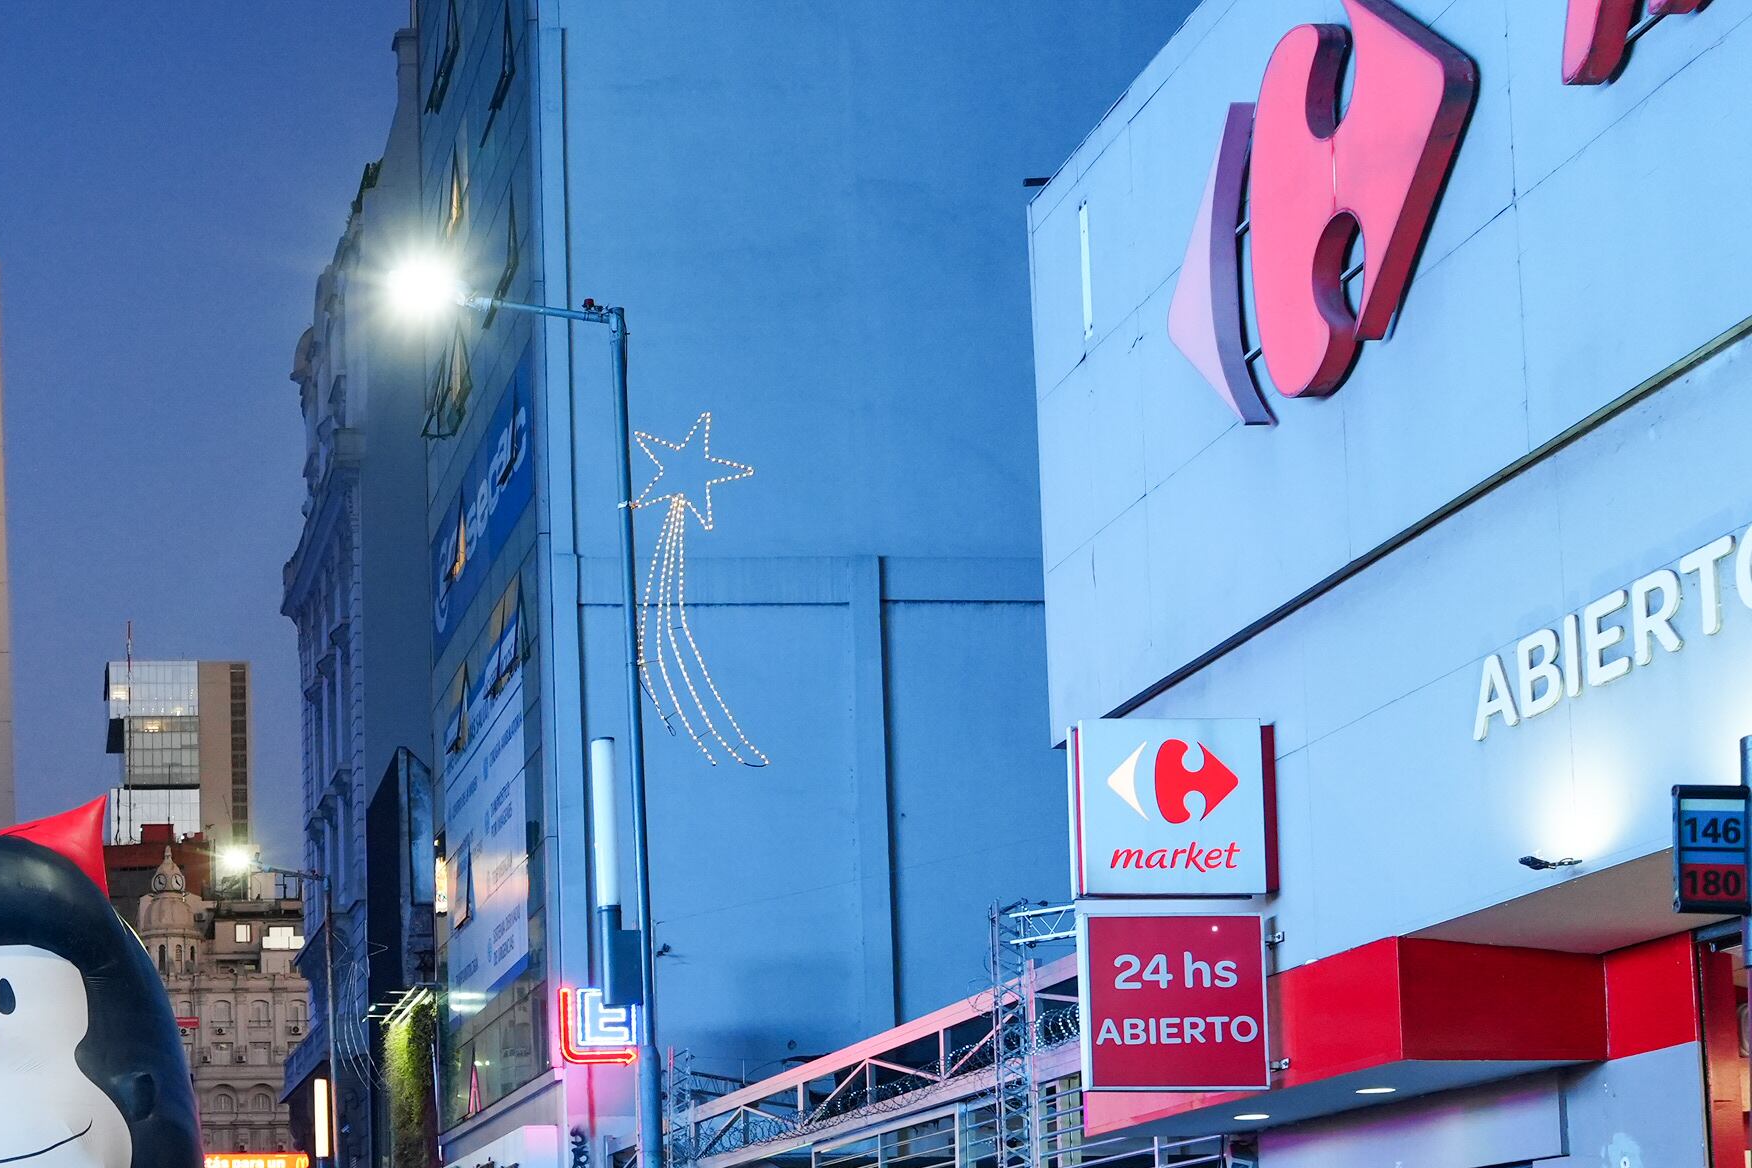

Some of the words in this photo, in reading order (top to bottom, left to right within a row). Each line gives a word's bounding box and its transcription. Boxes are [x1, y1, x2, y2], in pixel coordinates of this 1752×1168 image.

[1684, 817, 1741, 844] 146
[1111, 841, 1241, 873] market
[1685, 870, 1741, 896] 180
[1113, 953, 1174, 990] 24
[1183, 951, 1238, 988] hs
[1096, 1015, 1259, 1046] ABIERTO
[267, 1159, 286, 1168] un
